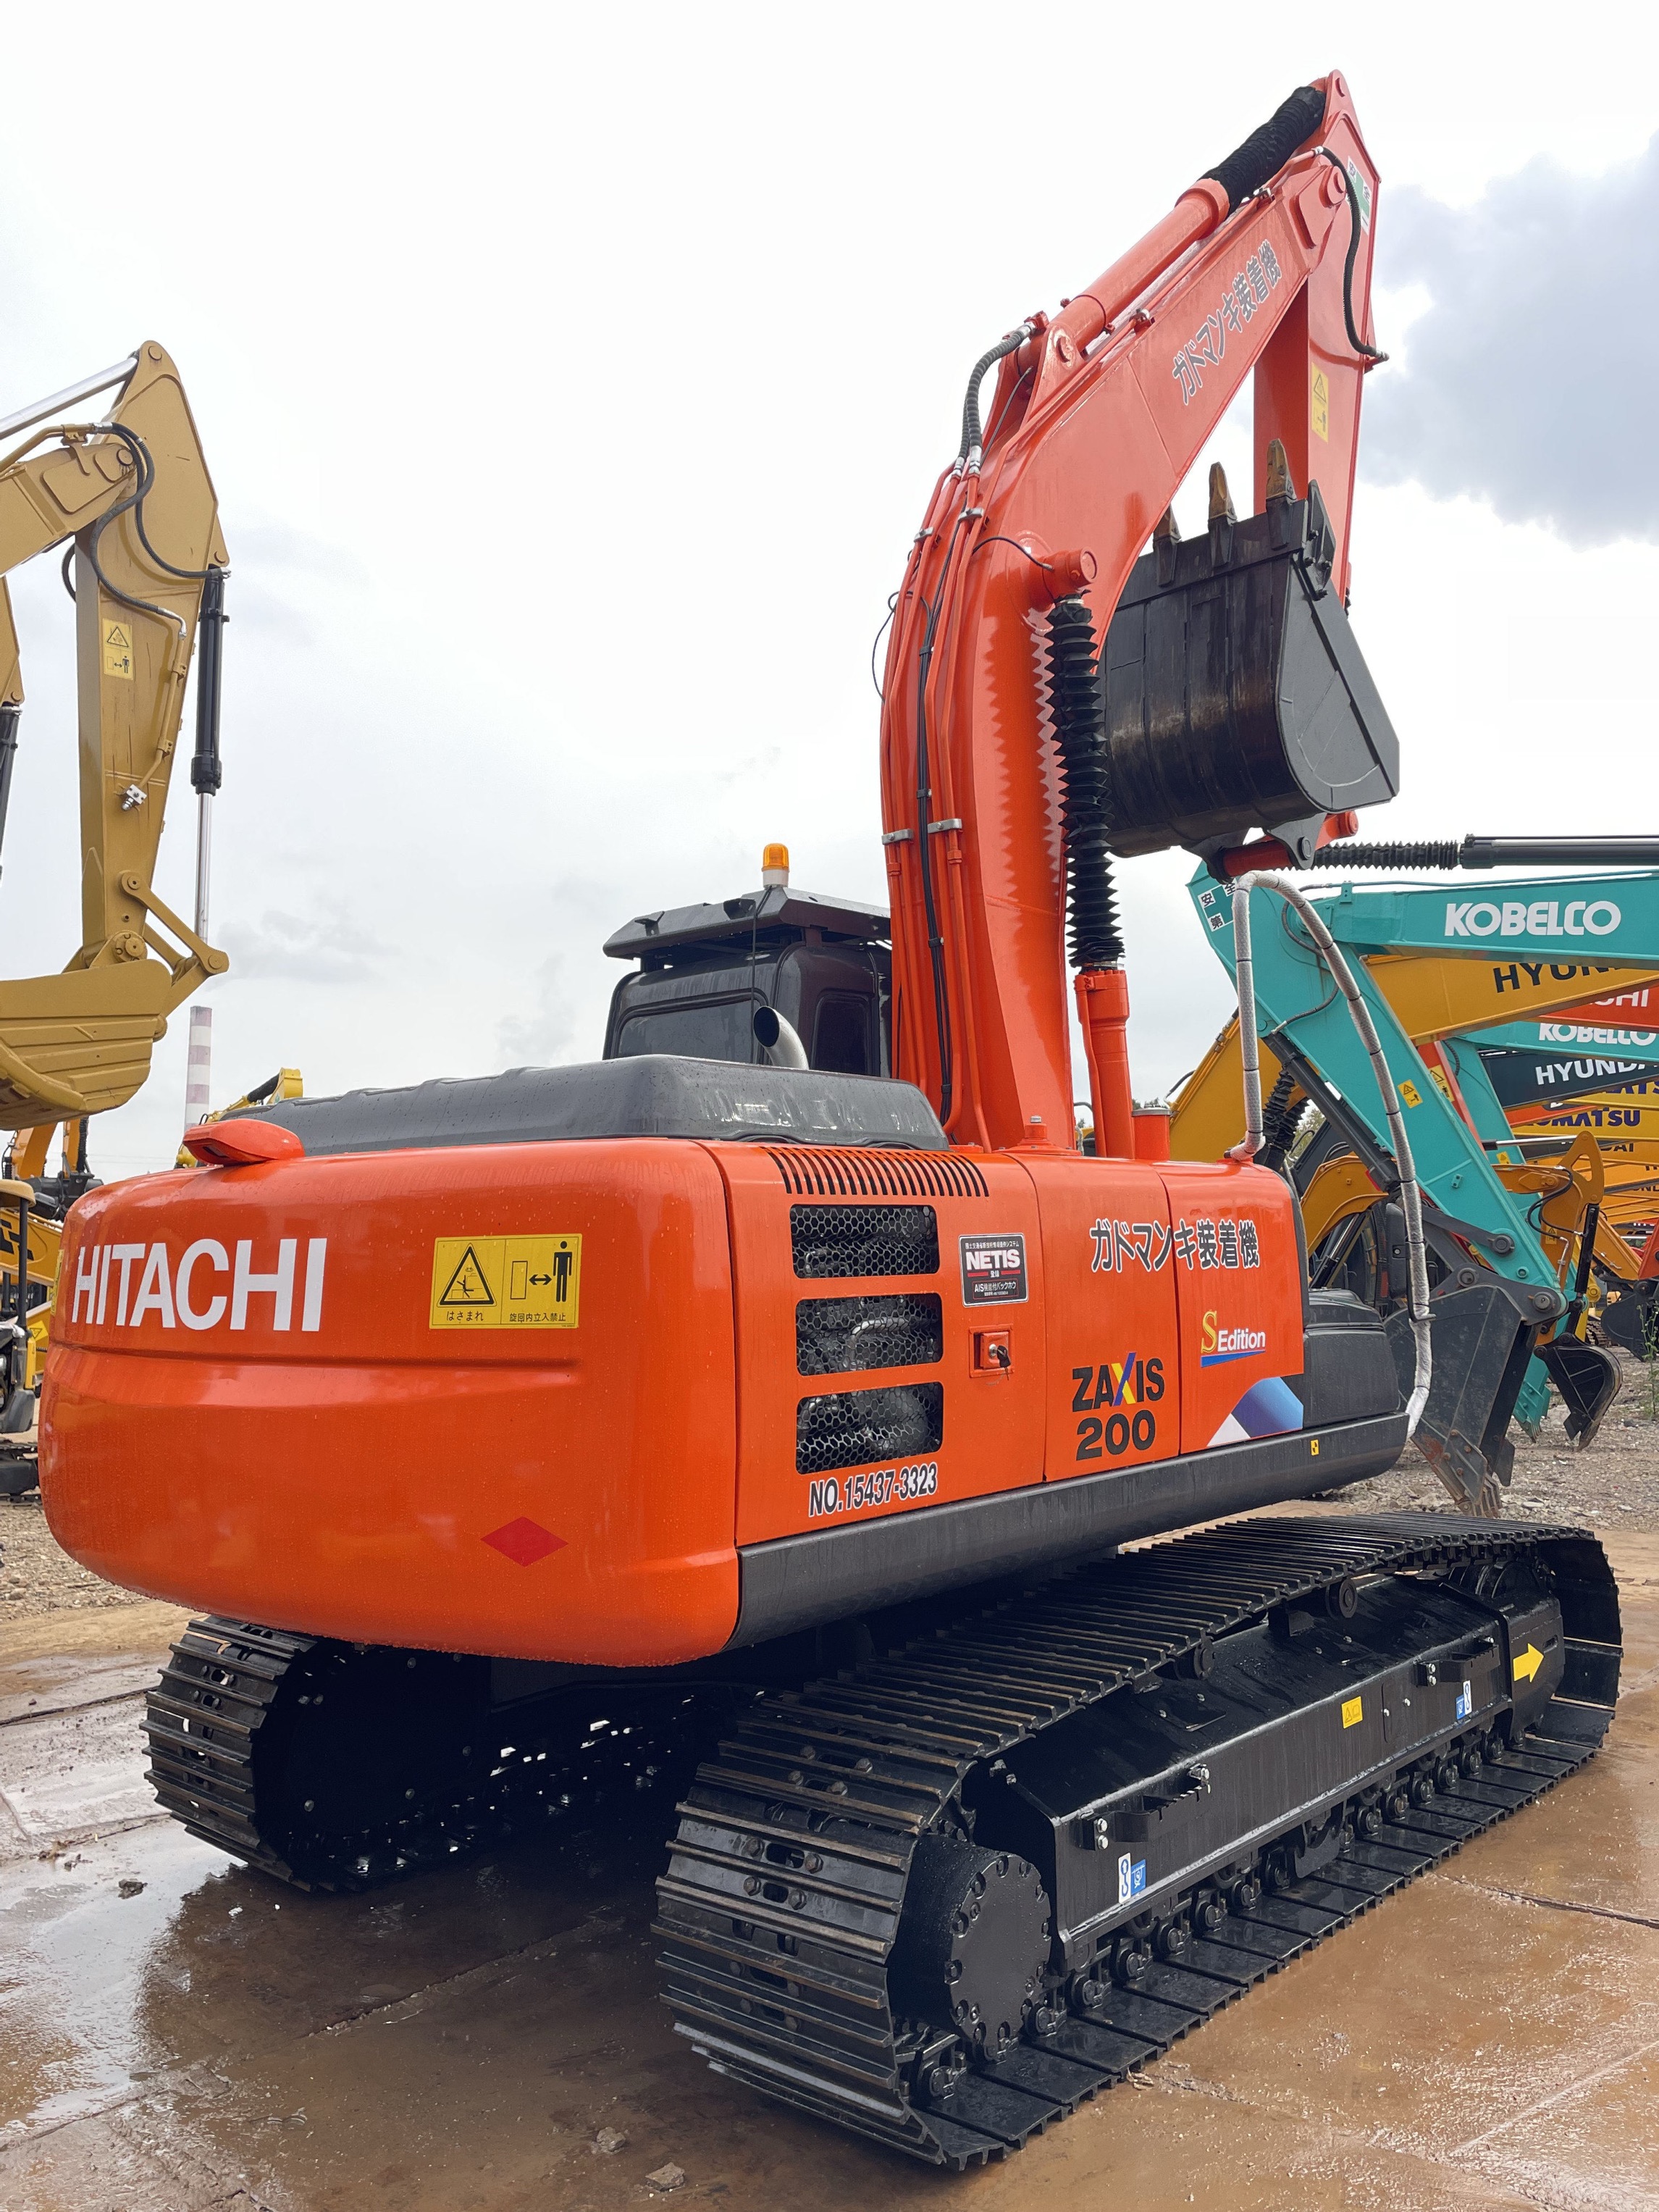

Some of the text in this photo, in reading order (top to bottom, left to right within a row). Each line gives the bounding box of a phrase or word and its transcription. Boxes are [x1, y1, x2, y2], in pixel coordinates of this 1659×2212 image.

[1172, 238, 1282, 406] ガドマンキ装着機
[1445, 900, 1621, 937] KOBELCO
[1492, 963, 1622, 993] HYU
[1539, 1023, 1657, 1046] KOBELCO
[1535, 1059, 1658, 1085] HYUND
[1526, 1110, 1640, 1127] MATSU
[965, 1249, 1021, 1270] NETIS
[1089, 1218, 1260, 1273] ガドマンキ装着機
[72, 1238, 327, 1331] HITACHI
[446, 1310, 484, 1322] はさまれ
[1201, 1310, 1266, 1354] S Edition
[1072, 1352, 1165, 1412] ZAXIS
[1076, 1409, 1156, 1461] 200
[809, 1462, 938, 1517] NO.15437-3323
